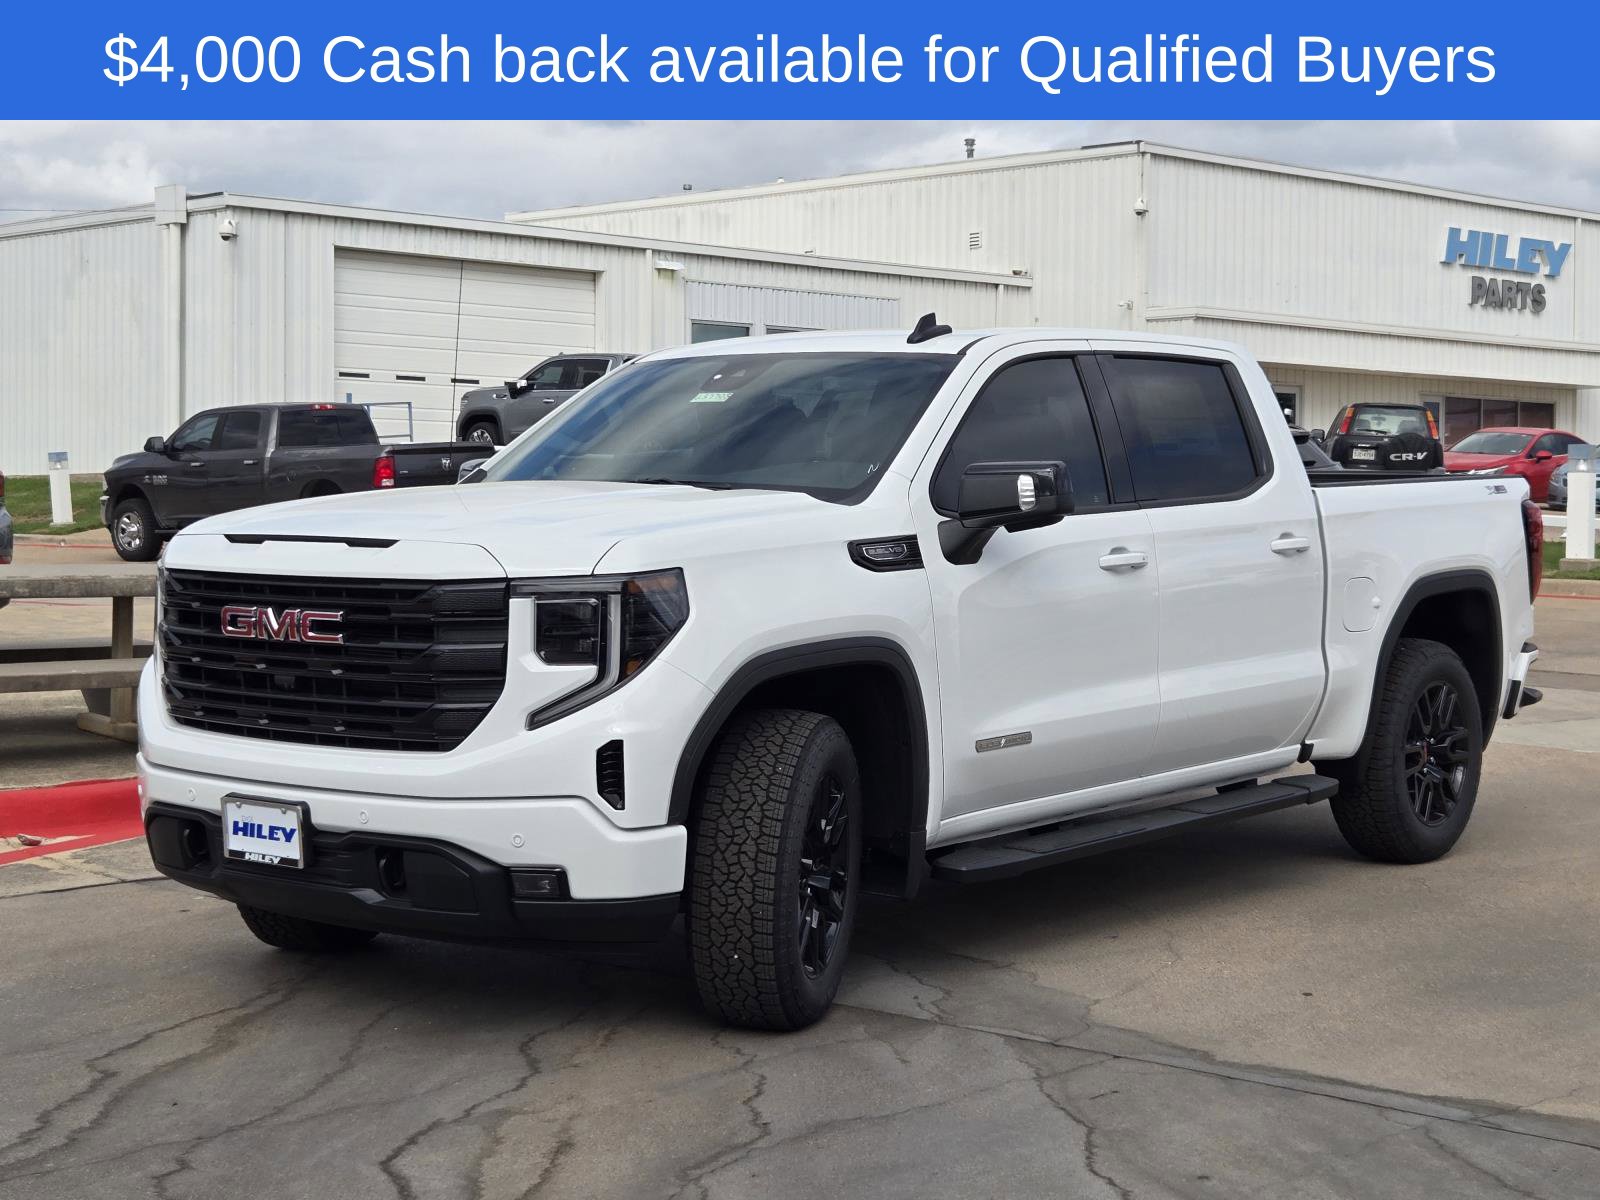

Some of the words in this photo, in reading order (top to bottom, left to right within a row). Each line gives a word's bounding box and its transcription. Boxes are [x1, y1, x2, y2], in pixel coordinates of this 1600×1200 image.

[1442, 227, 1572, 277] HILEY
[1470, 275, 1546, 312] PARTS
[1389, 451, 1428, 461] CR-V
[220, 605, 344, 645] GMC
[232, 820, 297, 843] HILEY
[244, 852, 281, 864] HILEY
